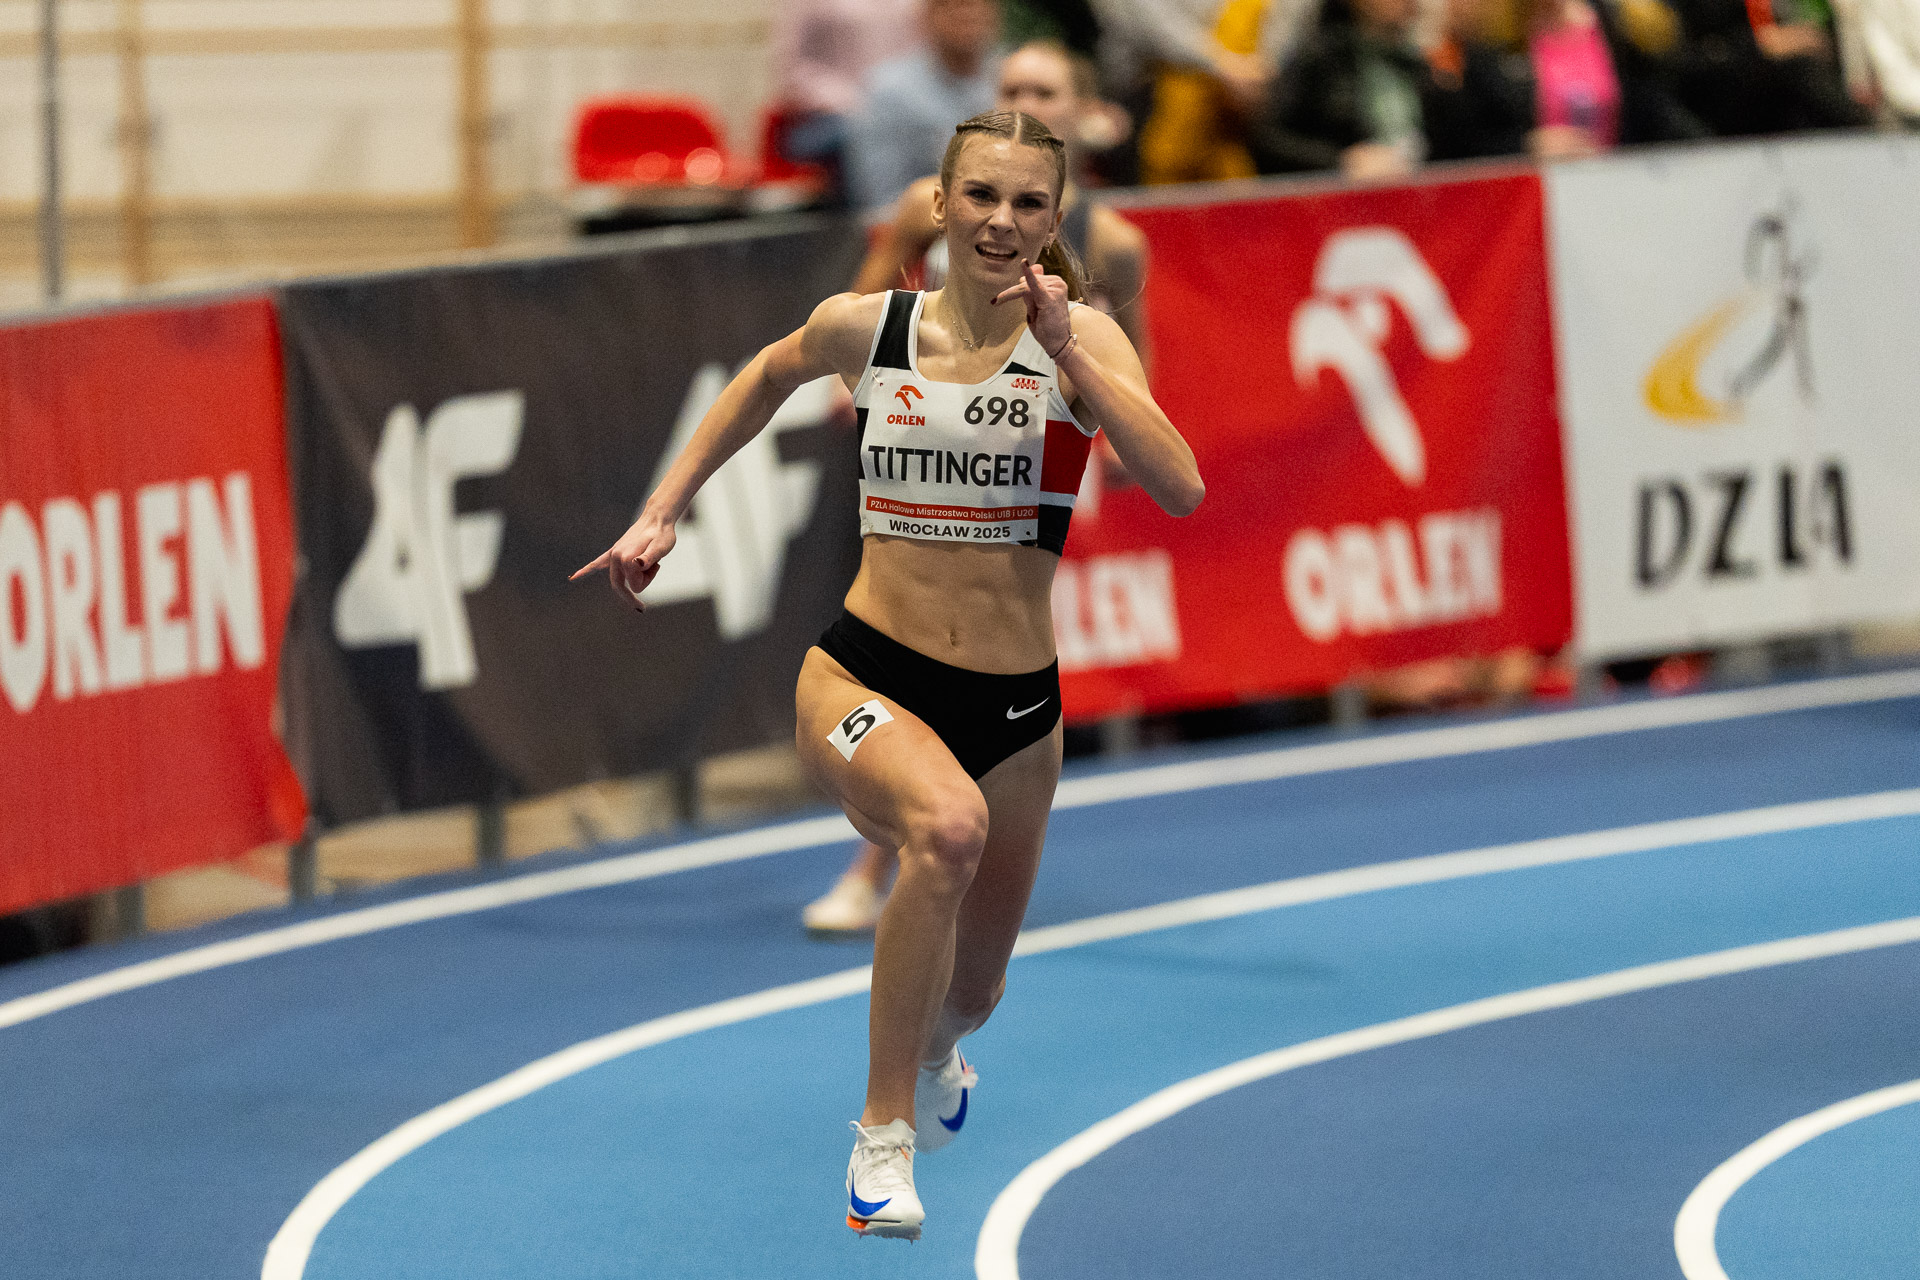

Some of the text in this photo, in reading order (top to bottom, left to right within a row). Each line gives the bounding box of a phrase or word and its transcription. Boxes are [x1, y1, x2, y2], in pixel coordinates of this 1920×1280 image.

[887, 414, 925, 427] ORLEN
[963, 395, 1029, 428] 698
[868, 445, 1033, 487] TITTINGER
[870, 500, 888, 510] PZLA
[889, 503, 915, 515] Halowe
[916, 507, 969, 518] Mistrzostwa
[970, 510, 996, 519] Polski
[997, 509, 1011, 519] U18
[1016, 507, 1034, 517] U20
[889, 519, 1011, 539] WROCŁAW 2025
[333, 389, 525, 691] 4F
[0, 471, 266, 713] ORLEN
[1282, 505, 1503, 643] ORLEN
[1052, 549, 1181, 670] LEN
[841, 706, 876, 744] 5
